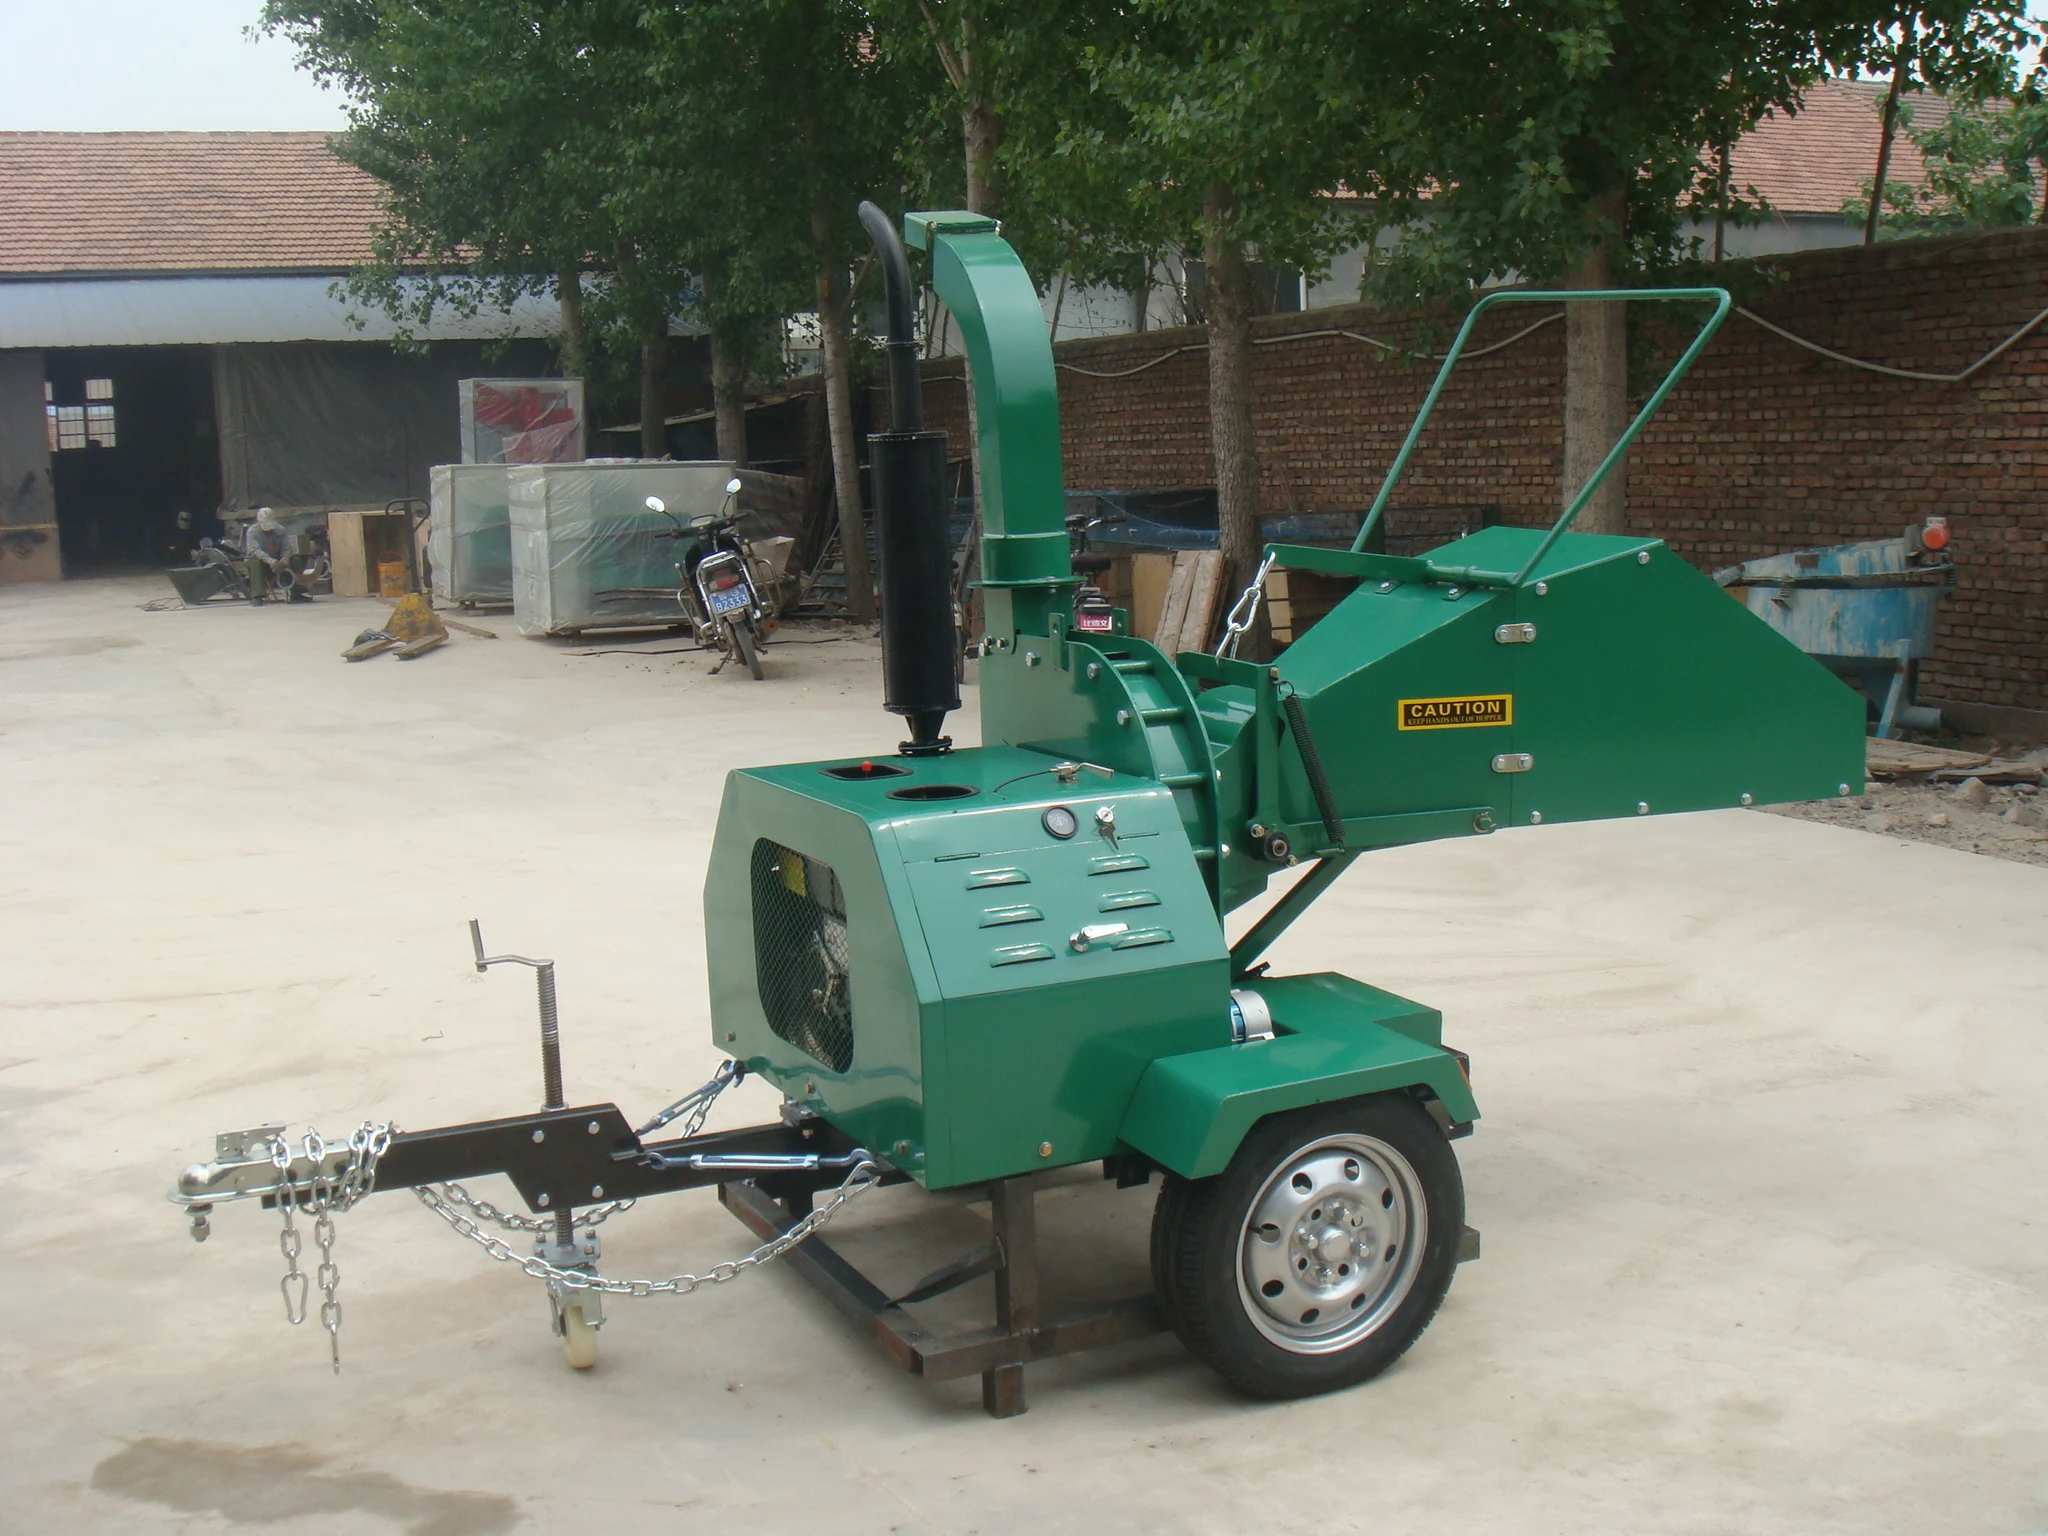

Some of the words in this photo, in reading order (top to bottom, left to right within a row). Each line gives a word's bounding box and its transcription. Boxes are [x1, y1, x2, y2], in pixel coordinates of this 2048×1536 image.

[716, 594, 748, 611] B2333
[1411, 701, 1500, 718] CAUTION
[1408, 718, 1426, 726] KEEP
[1476, 714, 1502, 722] HOPPER
